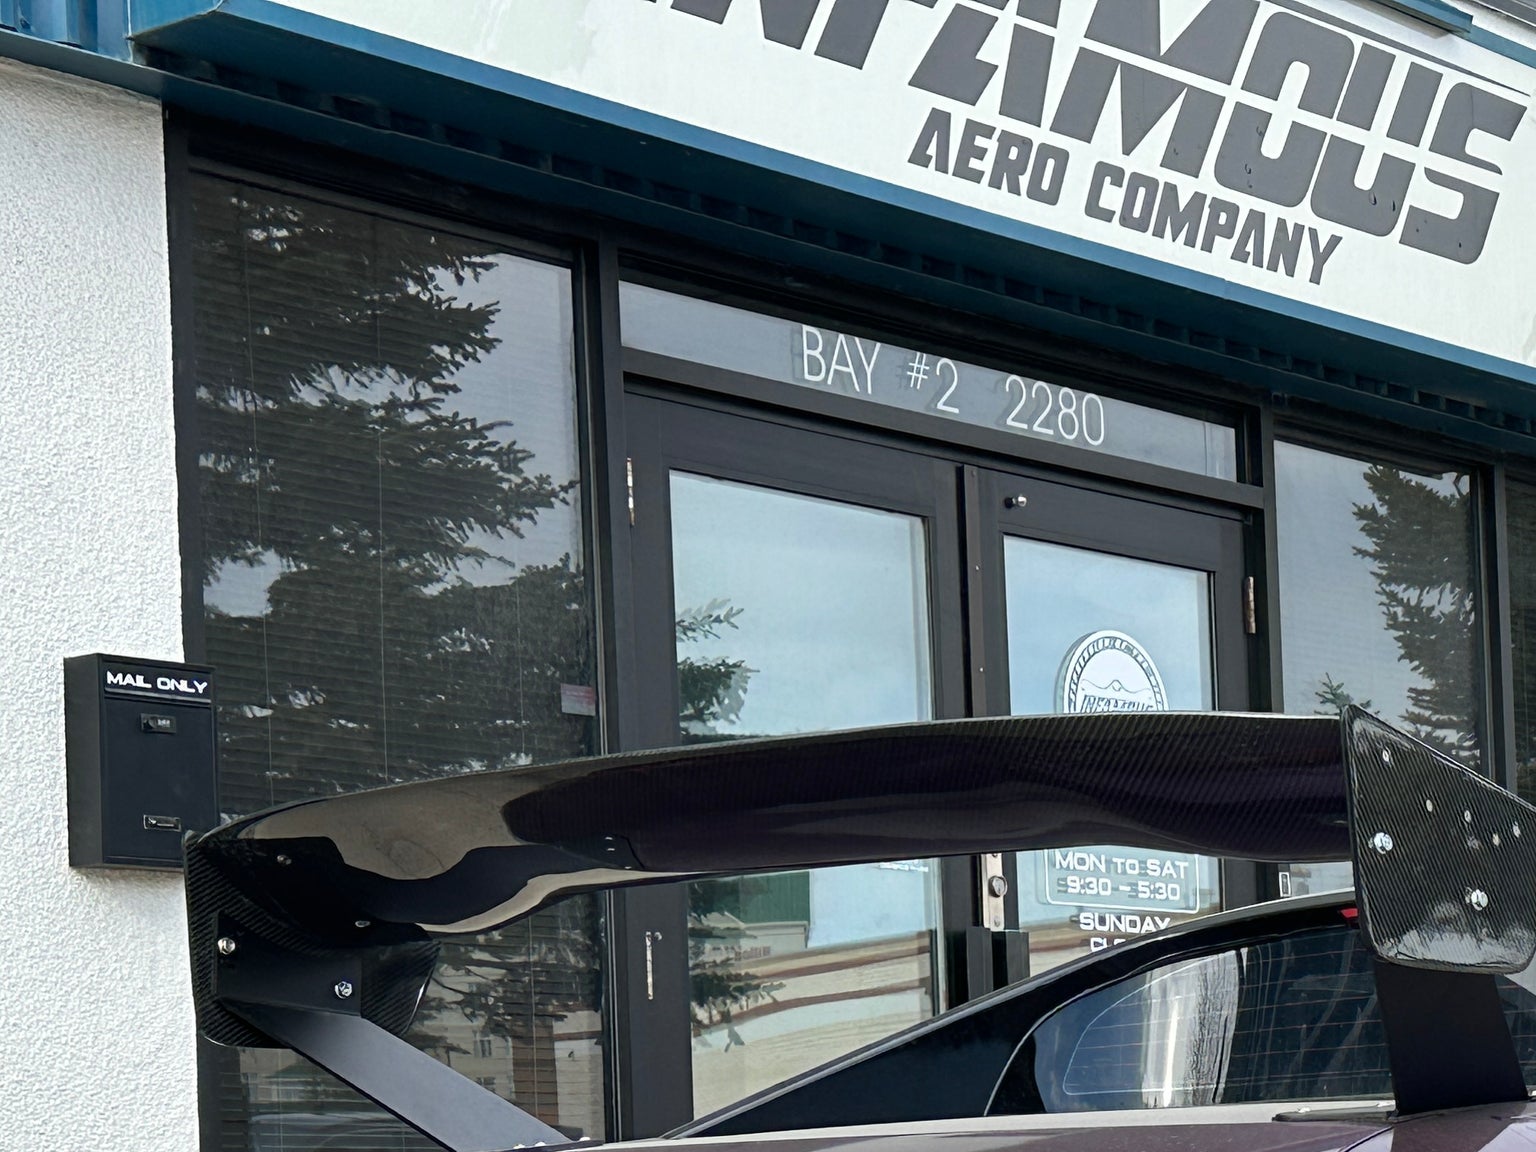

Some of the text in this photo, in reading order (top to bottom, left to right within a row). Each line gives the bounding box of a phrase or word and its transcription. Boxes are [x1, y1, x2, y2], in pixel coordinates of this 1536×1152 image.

[645, 0, 1530, 265] AMOUS
[908, 107, 1343, 286] AERO COMPANY
[802, 324, 1105, 446] BAY #2 2280
[106, 670, 208, 694] MAIL ONLY
[1055, 851, 1189, 879] MON TO SAT
[1066, 875, 1112, 896] 9:30
[1137, 880, 1181, 901] 5:30
[1080, 912, 1171, 934] SUNDAY
